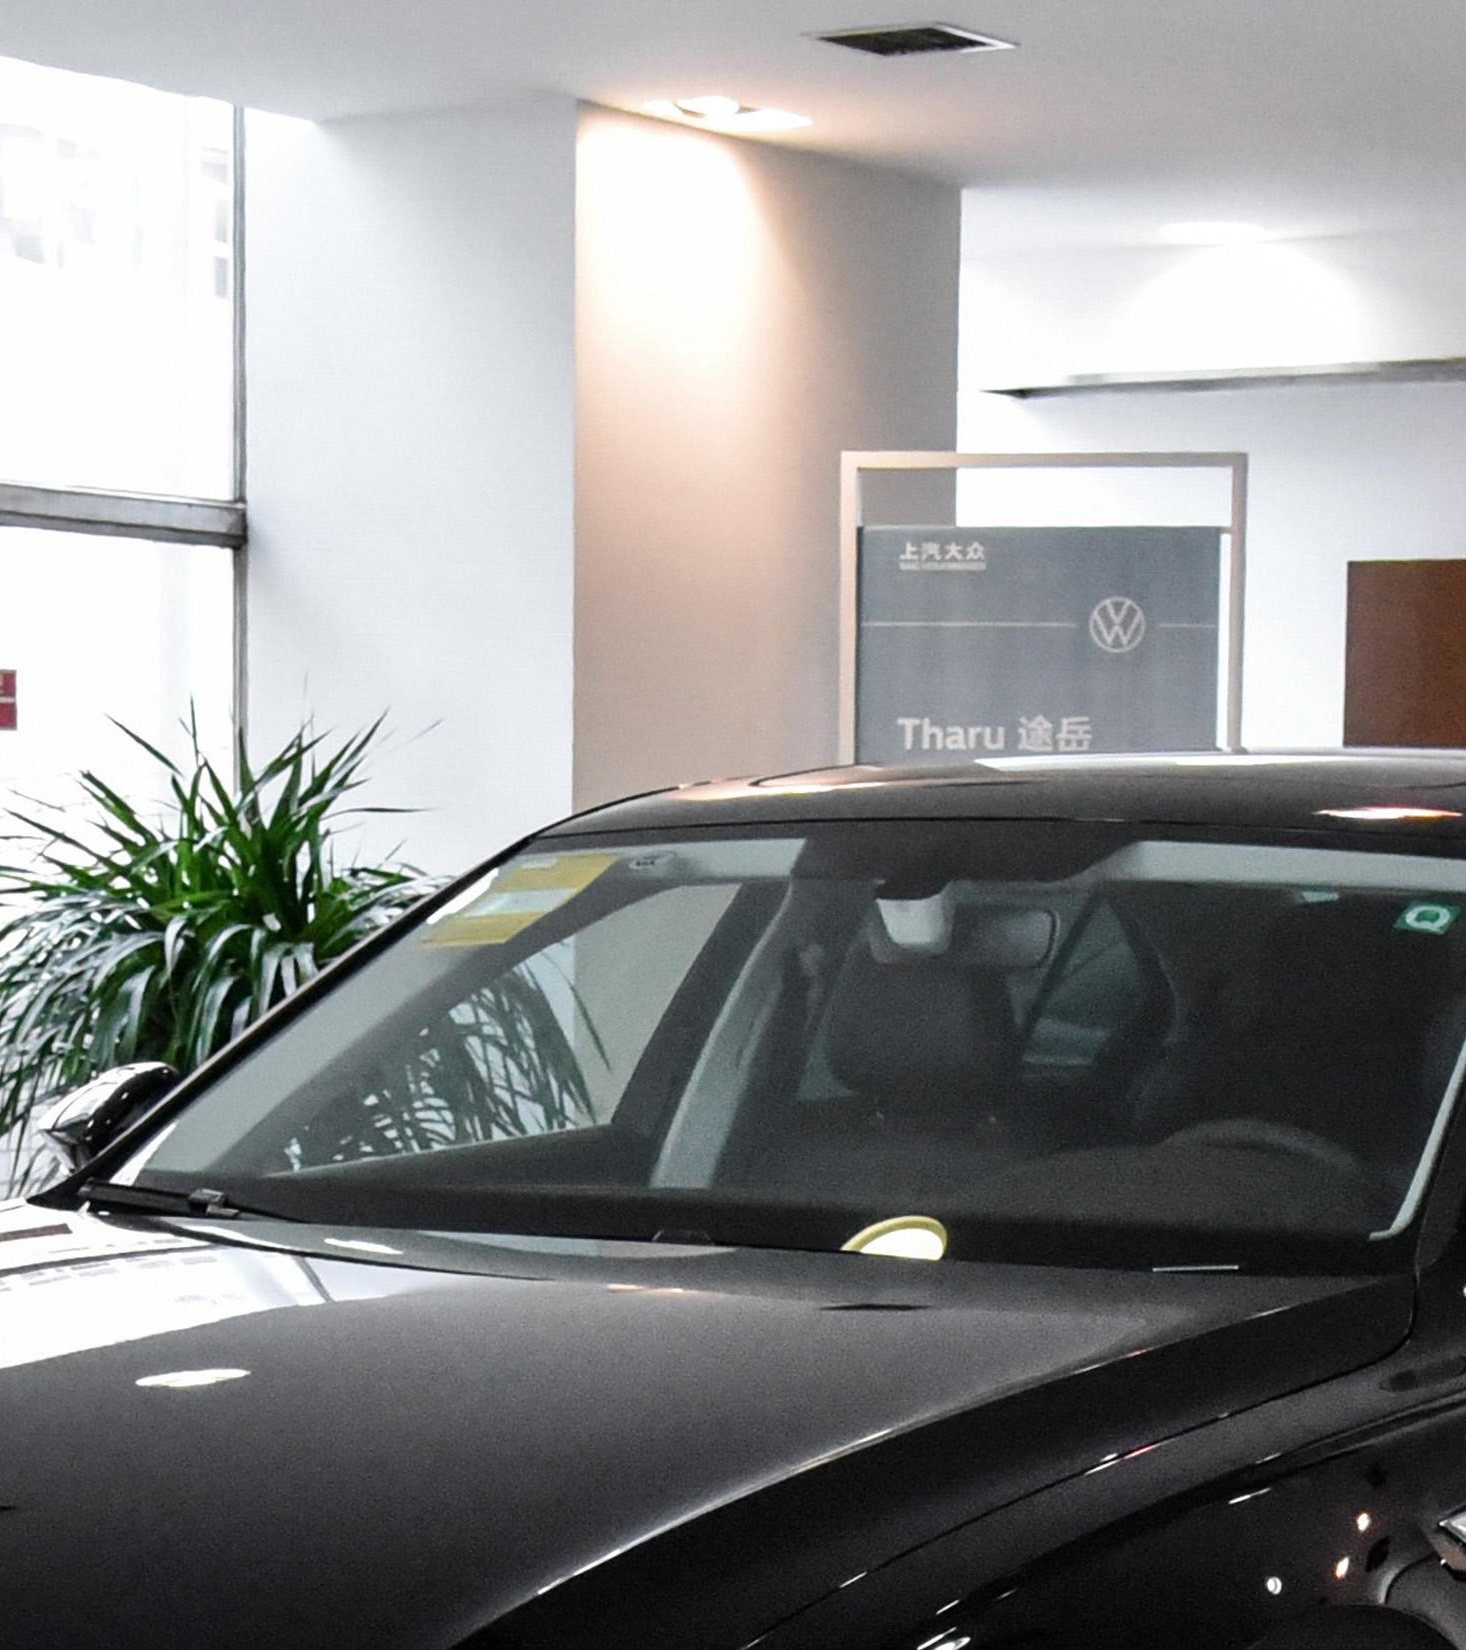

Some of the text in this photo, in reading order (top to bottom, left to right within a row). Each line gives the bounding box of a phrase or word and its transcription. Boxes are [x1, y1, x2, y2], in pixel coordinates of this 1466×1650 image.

[898, 541, 986, 561] 上汽大众
[896, 714, 1093, 752] Tharu 途岳
